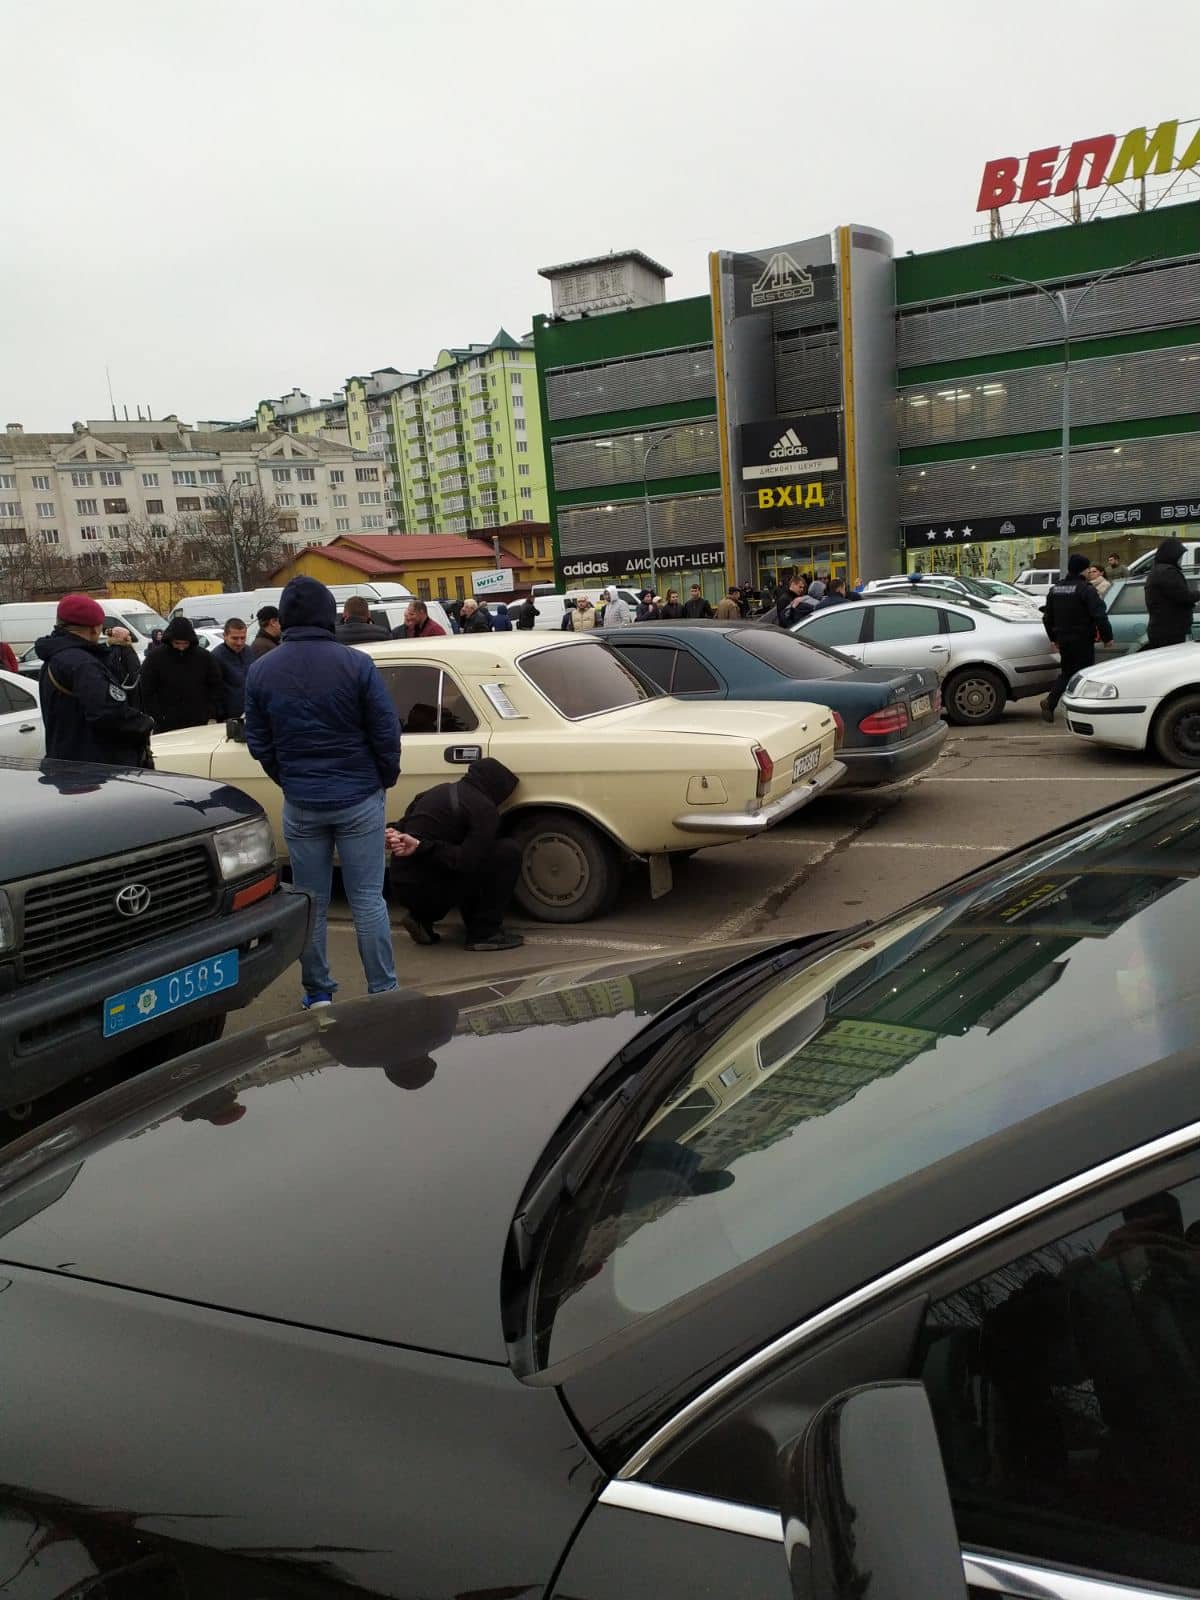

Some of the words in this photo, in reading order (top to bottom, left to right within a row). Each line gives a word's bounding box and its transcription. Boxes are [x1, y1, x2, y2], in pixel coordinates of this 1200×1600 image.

[769, 445, 808, 458] adidas
[758, 482, 825, 509] ВХІД
[563, 561, 609, 576] adidas
[476, 575, 504, 587] WILO
[168, 960, 224, 1004] 0585
